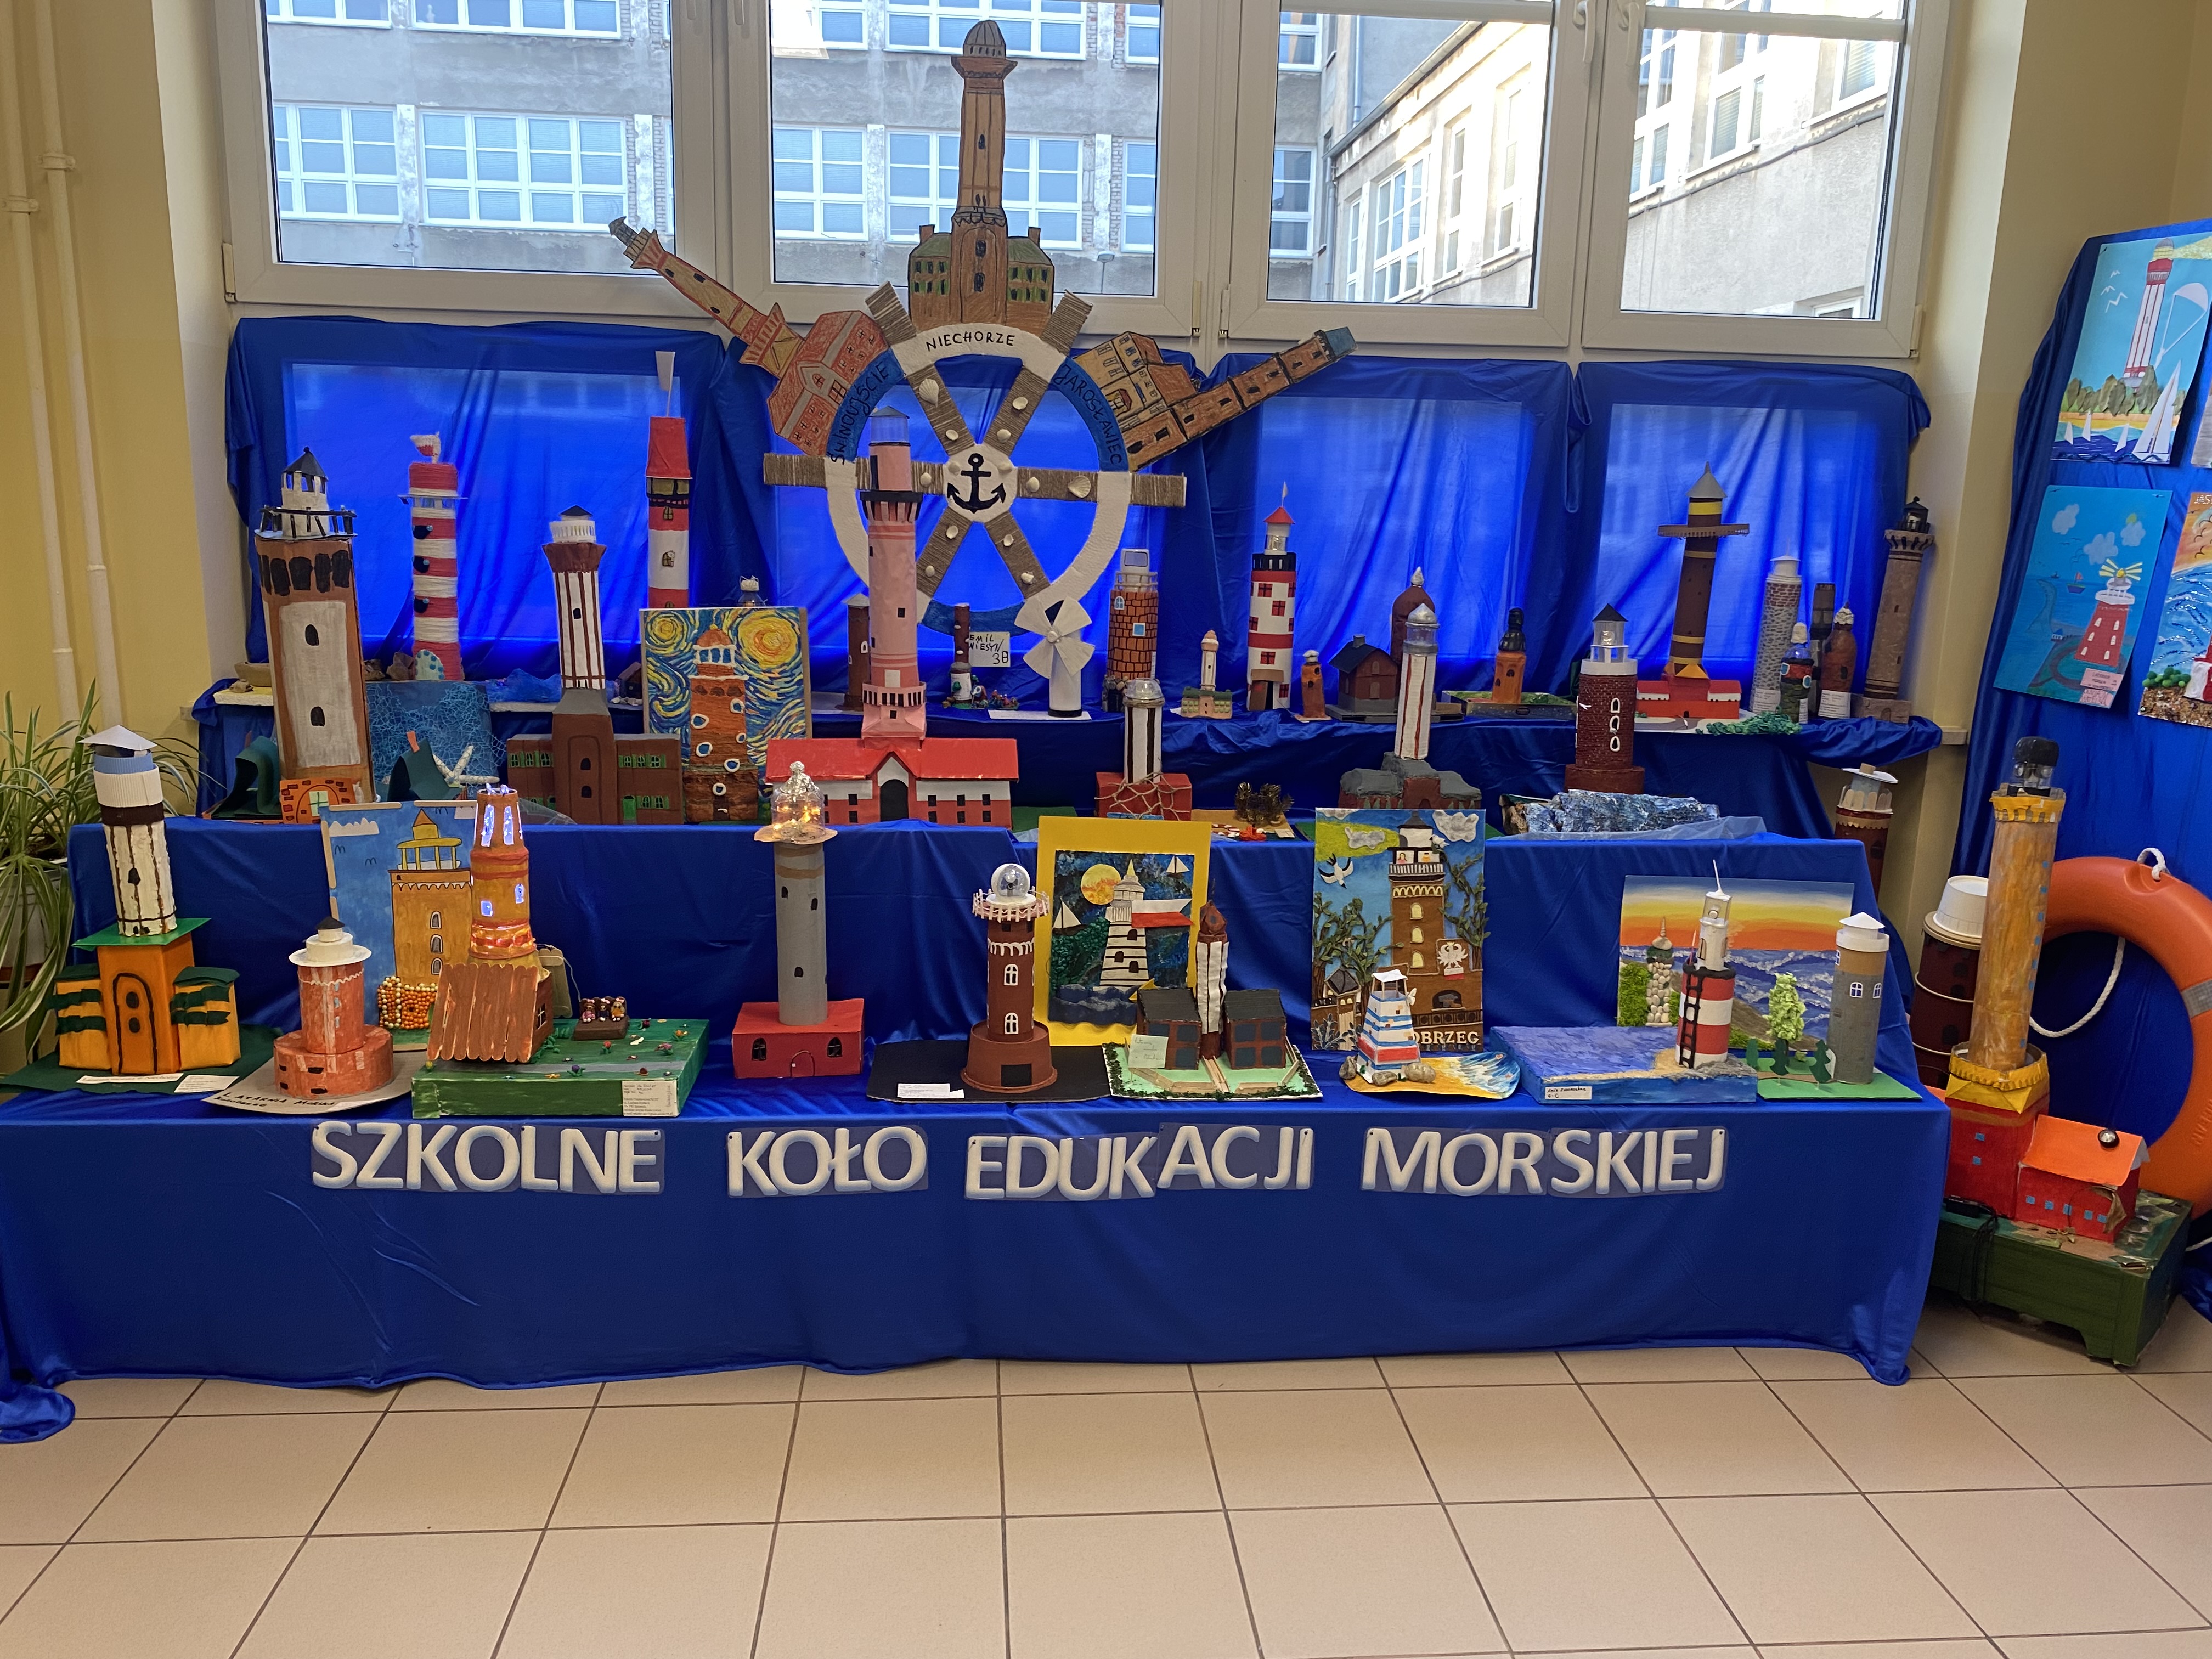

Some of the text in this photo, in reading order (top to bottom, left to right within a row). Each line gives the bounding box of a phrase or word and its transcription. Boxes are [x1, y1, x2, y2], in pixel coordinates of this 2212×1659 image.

[926, 331, 1015, 352] NIECHORZE
[992, 651, 1009, 665] 3B
[312, 1120, 1726, 1201] SZKOLNE KOŁO EDUKACJI MORSKIEJ
